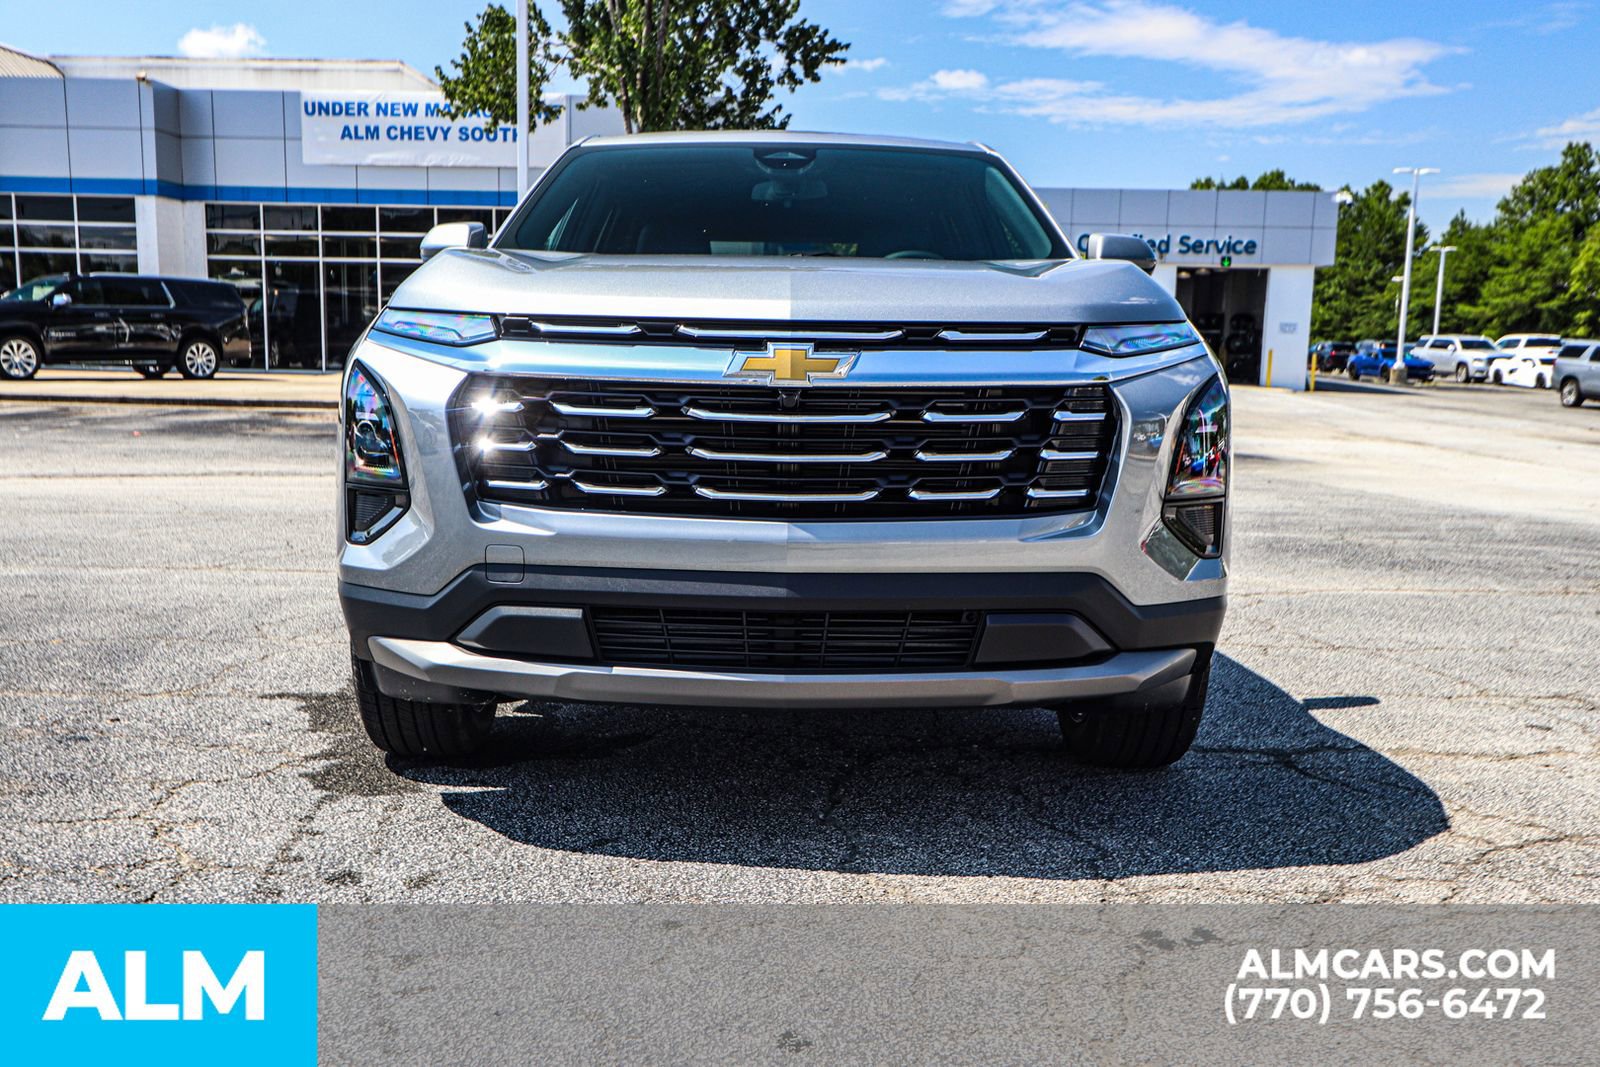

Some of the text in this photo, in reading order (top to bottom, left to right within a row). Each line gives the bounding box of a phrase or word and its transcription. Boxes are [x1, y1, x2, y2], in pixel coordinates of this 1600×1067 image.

[304, 101, 369, 117] UNDER
[375, 102, 419, 117] NEW
[340, 124, 380, 140] ALM
[386, 124, 452, 142] CHEVY
[1178, 234, 1257, 255] Service
